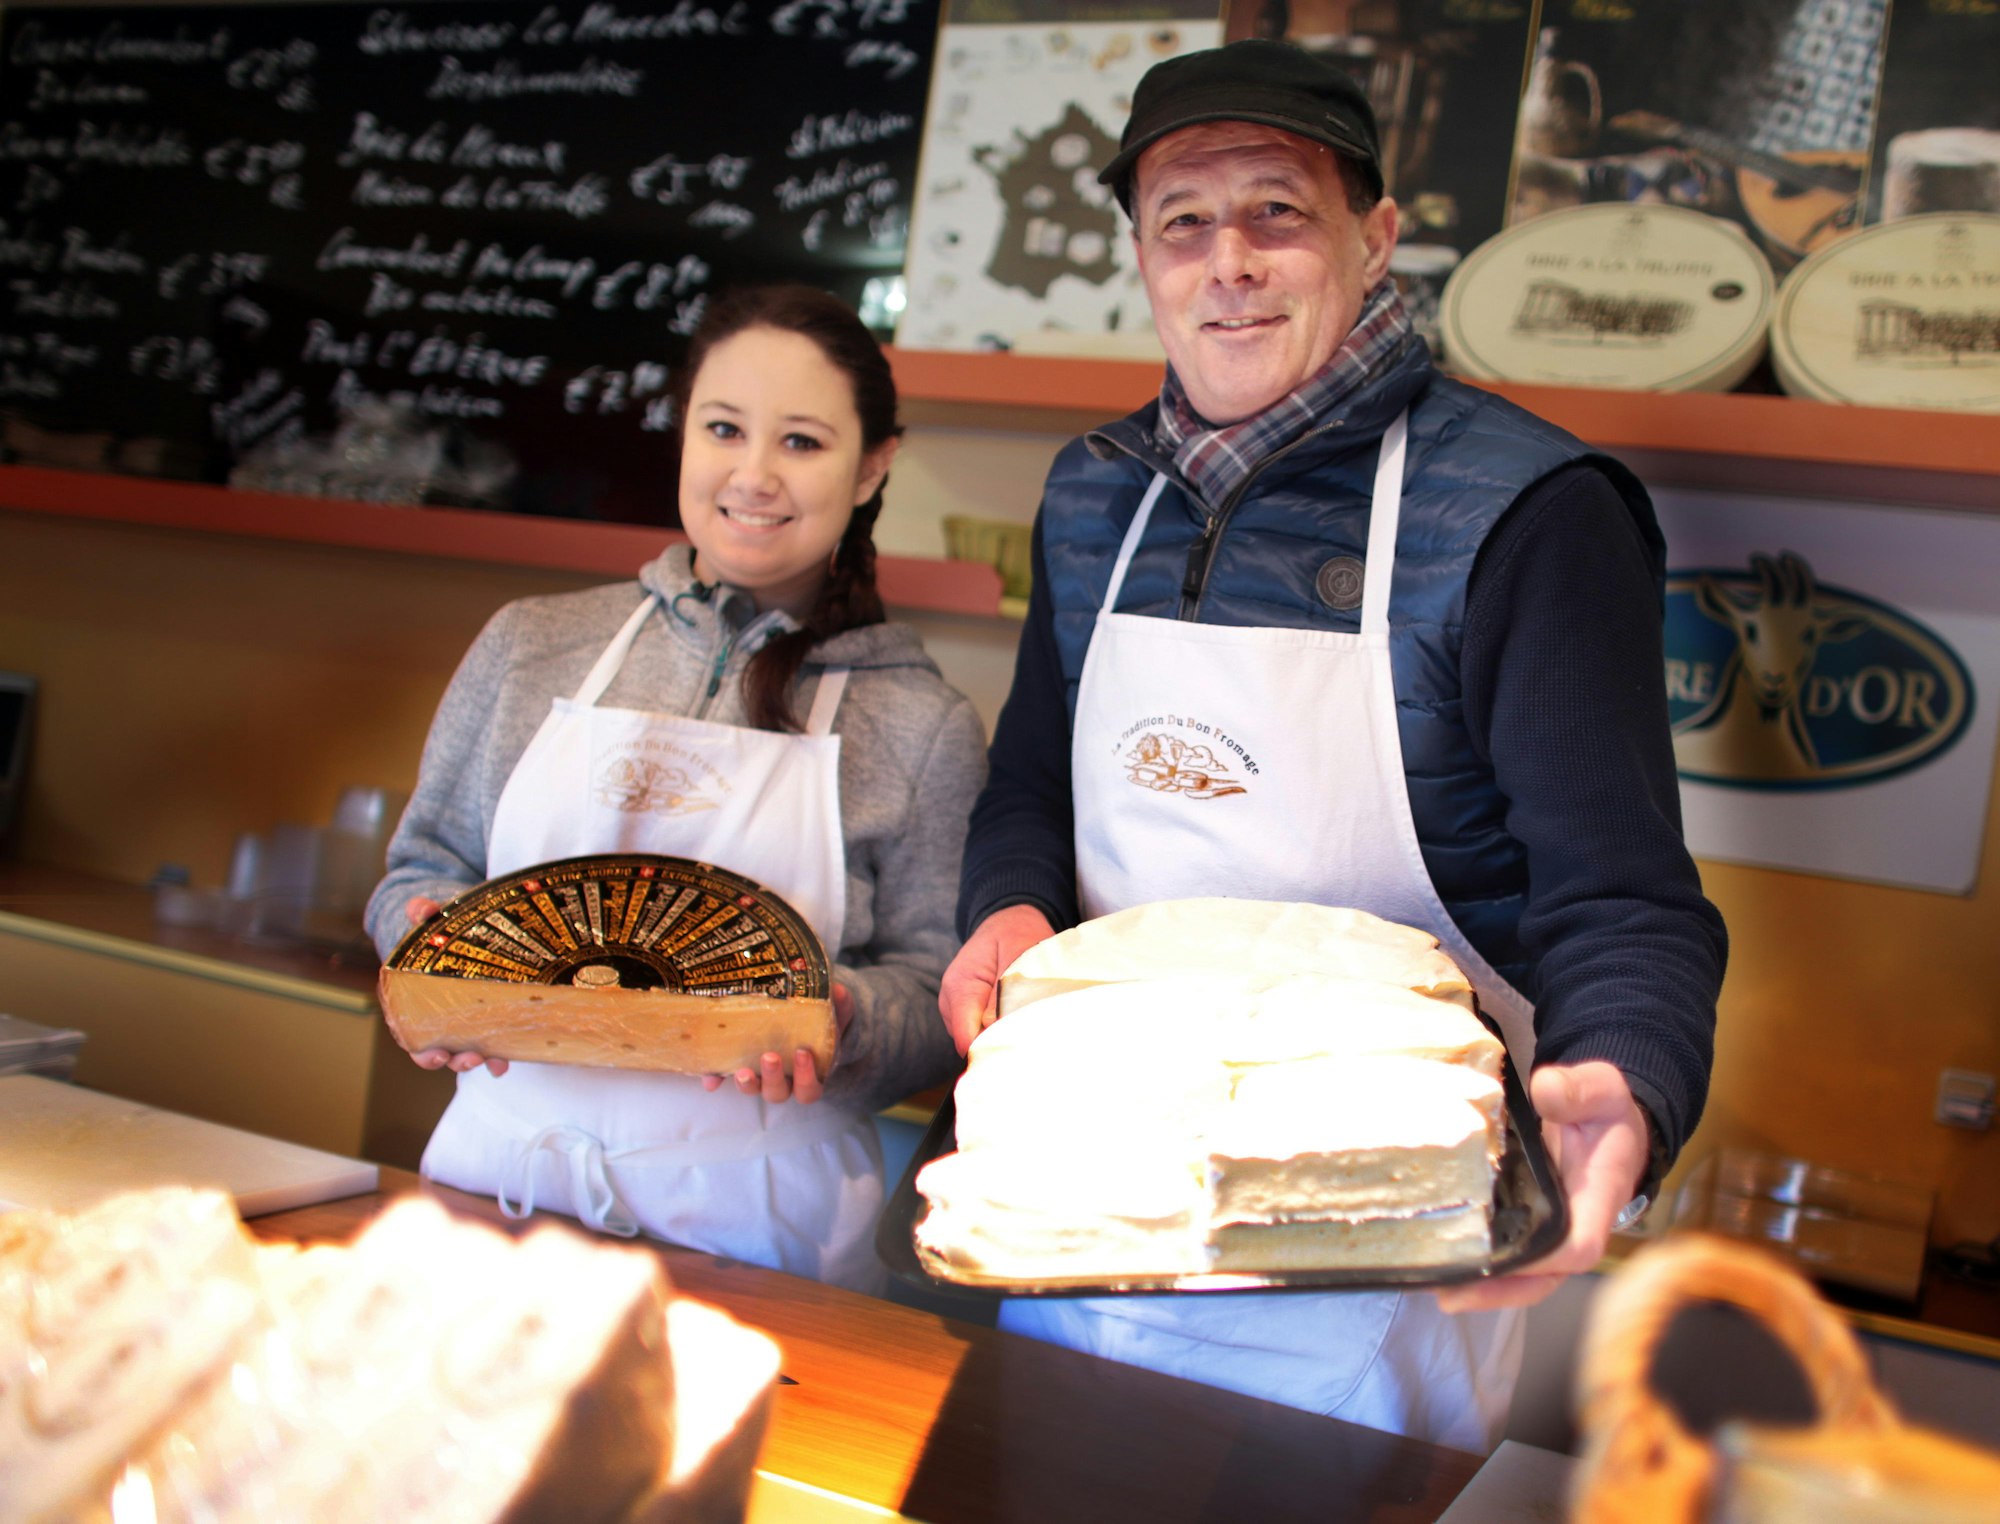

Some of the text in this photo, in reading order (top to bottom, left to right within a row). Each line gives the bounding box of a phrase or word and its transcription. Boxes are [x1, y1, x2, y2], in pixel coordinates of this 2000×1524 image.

[1807, 664, 1941, 729] D'OR
[1122, 716, 1164, 741] Tradition
[1167, 714, 1184, 727] Du
[1186, 717, 1212, 735] Bon
[1213, 727, 1261, 776] Fromage
[683, 950, 764, 980] Appenzeller
